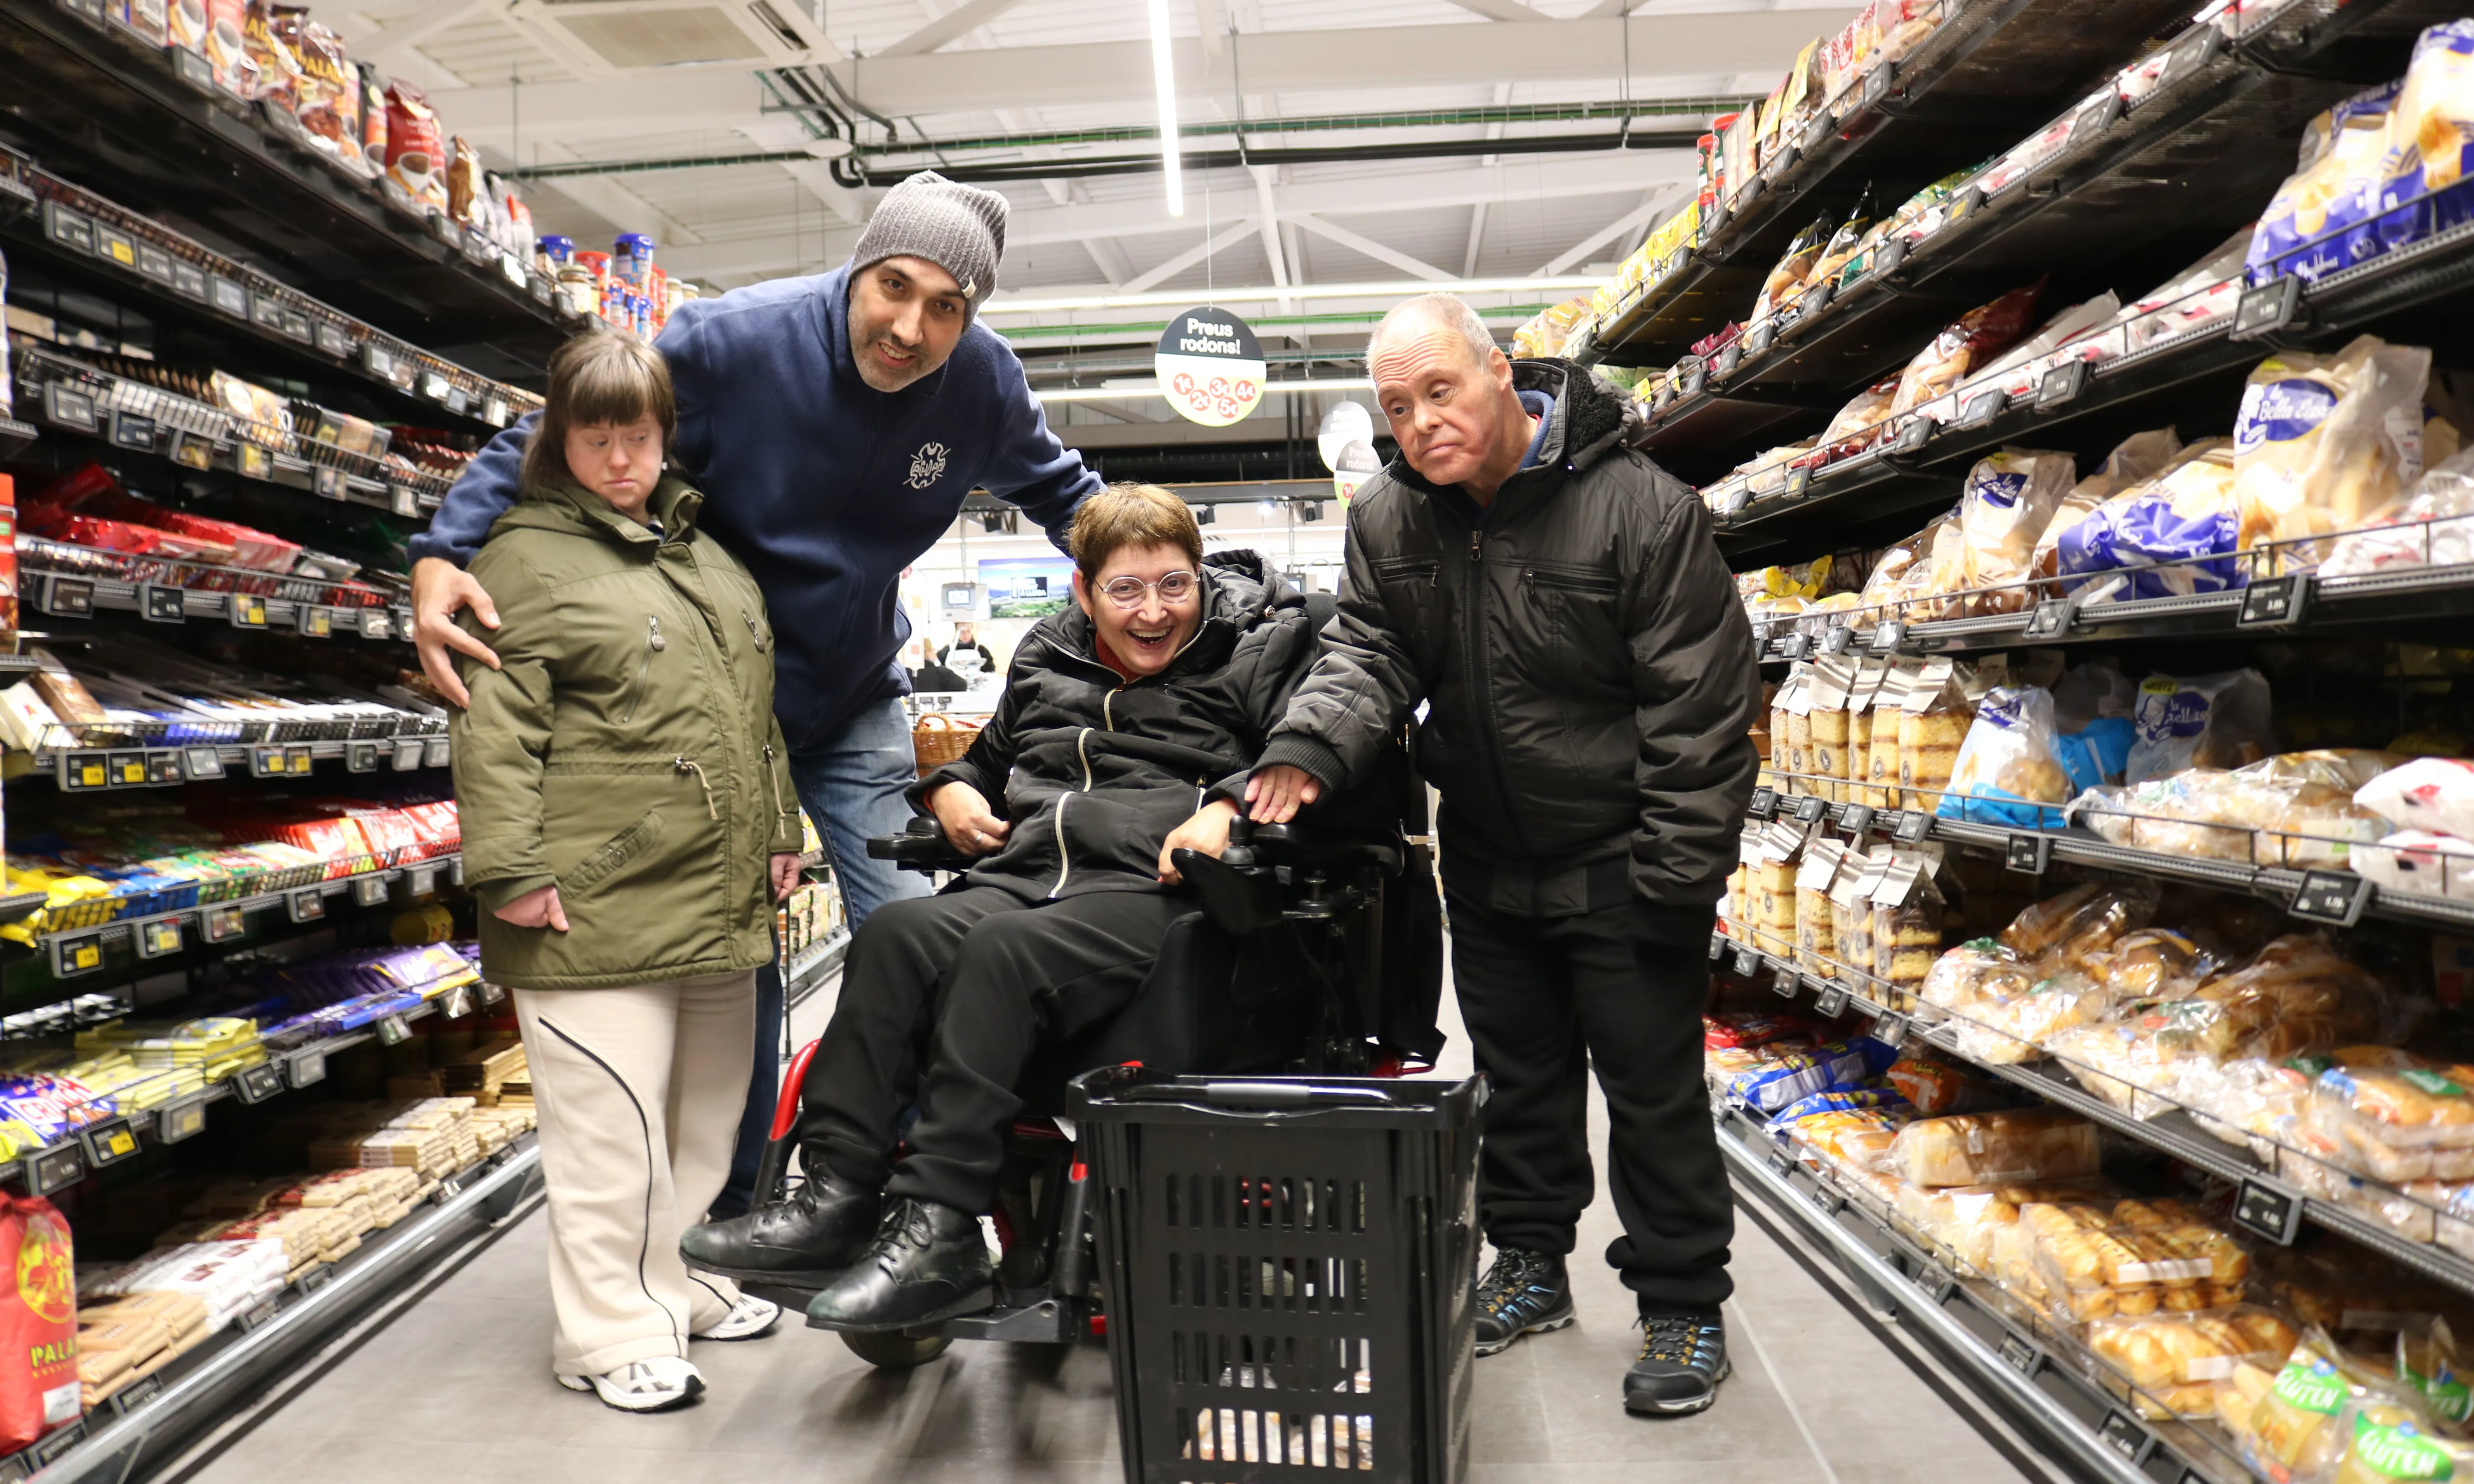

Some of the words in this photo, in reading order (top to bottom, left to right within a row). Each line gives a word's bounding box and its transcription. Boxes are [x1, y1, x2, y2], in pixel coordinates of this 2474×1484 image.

[1187, 318, 1234, 337] Preus
[1180, 336, 1241, 355] rodons!
[1176, 376, 1192, 393] 1€
[1211, 379, 1229, 394] 3€
[1237, 383, 1254, 399] 4€
[1192, 394, 1209, 411] 2€
[1219, 399, 1237, 415] 5€
[1346, 460, 1374, 470] rodons!
[19, 1078, 92, 1120] CRUNCH
[2274, 1367, 2340, 1410] GLUTEN
[2357, 1429, 2439, 1477] GLUTEN
